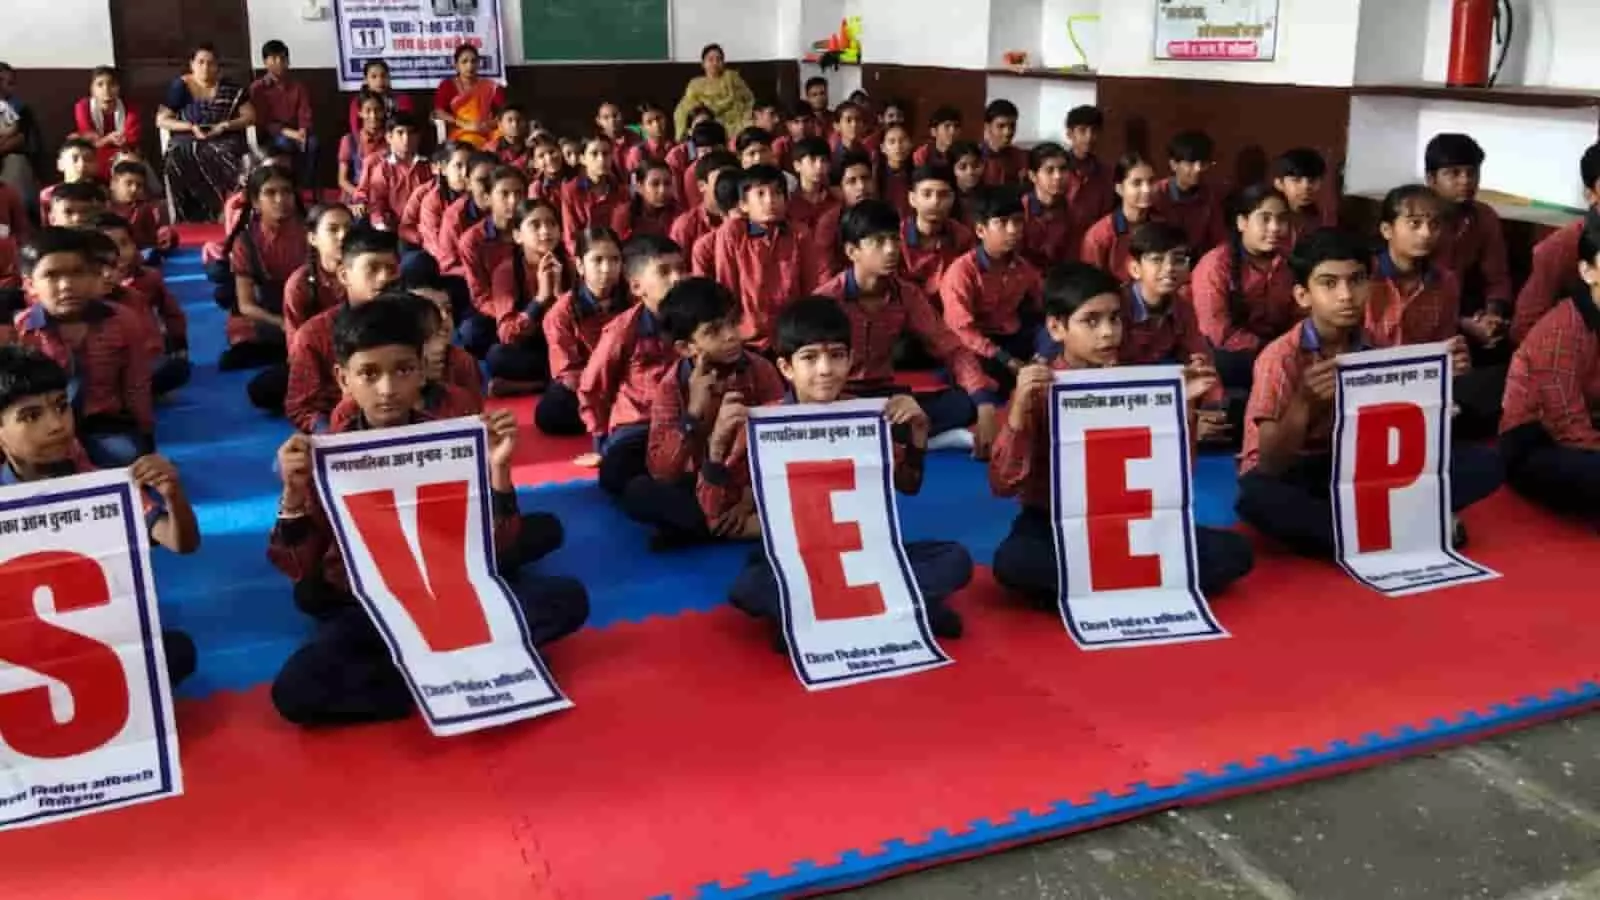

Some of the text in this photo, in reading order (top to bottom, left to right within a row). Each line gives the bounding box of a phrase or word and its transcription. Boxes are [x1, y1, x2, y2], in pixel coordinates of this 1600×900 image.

[359, 30, 376, 47] 11
[22, 513, 48, 532] आम
[50, 508, 81, 533] चुनाव
[91, 503, 121, 521] 2026
[785, 458, 887, 621] E
[1084, 425, 1162, 592] E
[1354, 402, 1426, 553] P
[341, 480, 494, 653] V
[0, 549, 129, 759] S
